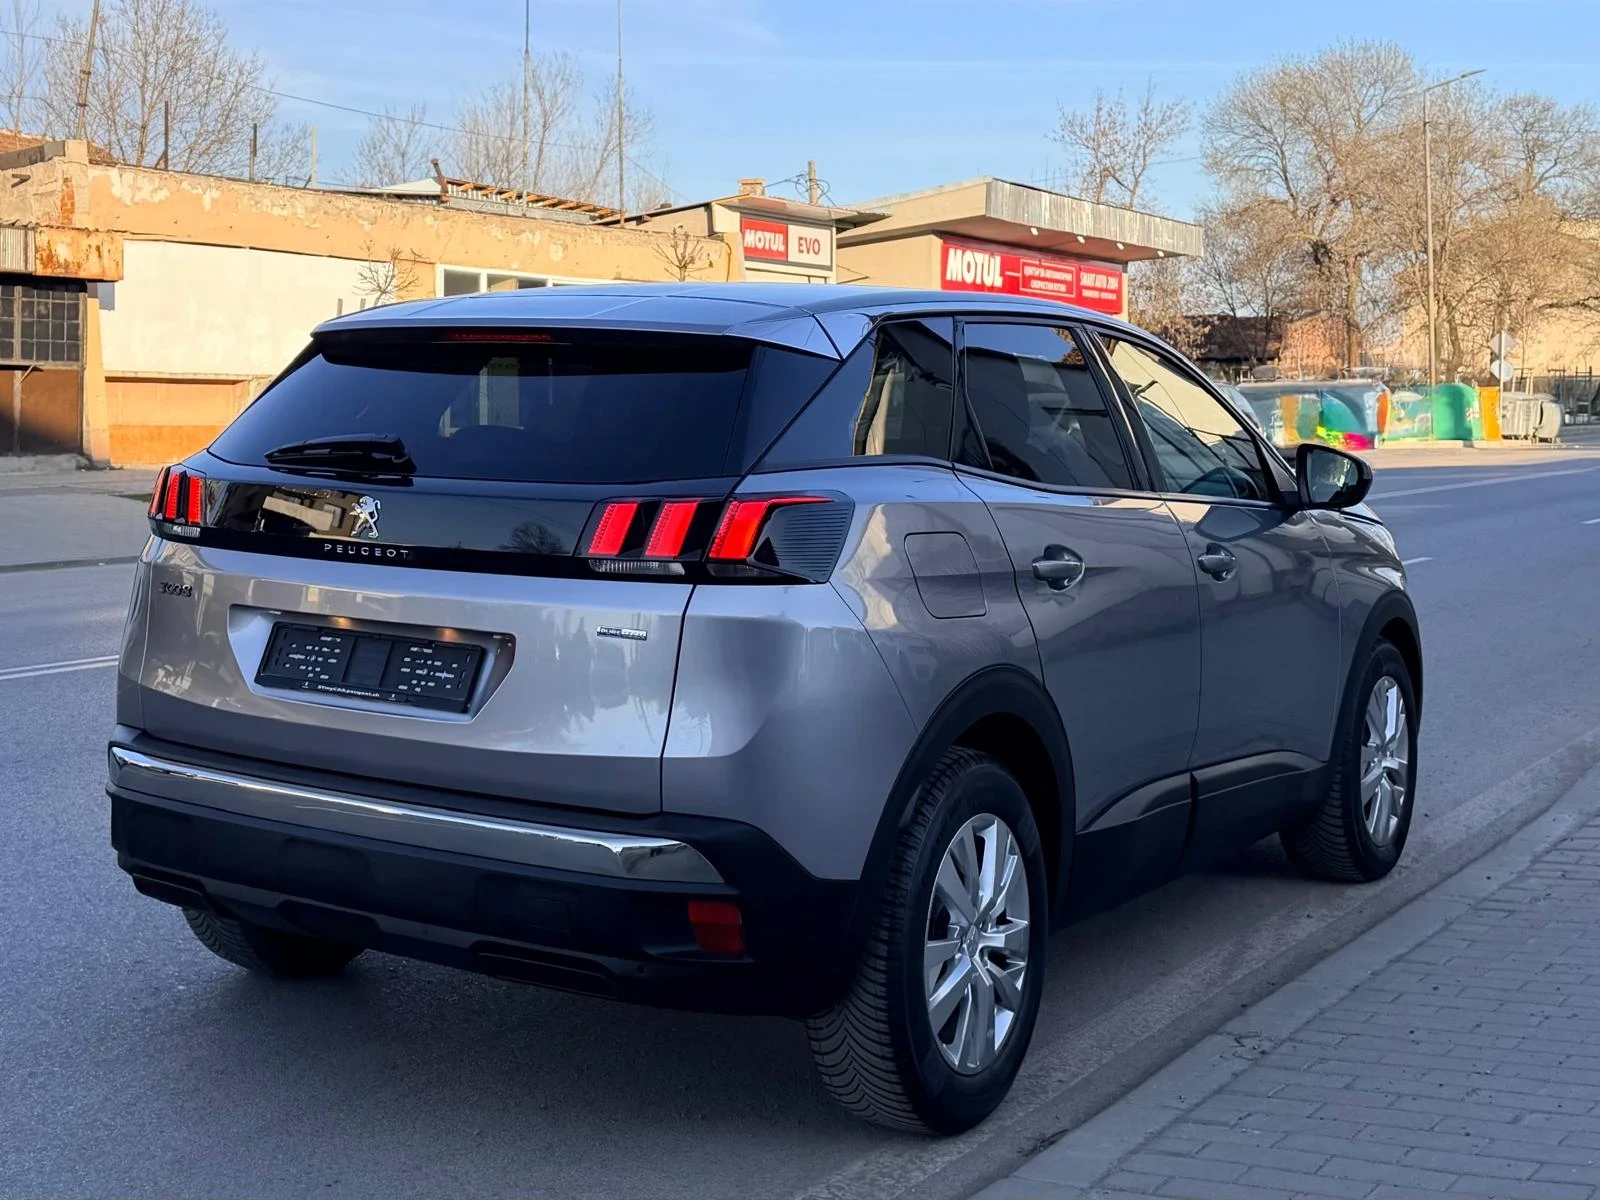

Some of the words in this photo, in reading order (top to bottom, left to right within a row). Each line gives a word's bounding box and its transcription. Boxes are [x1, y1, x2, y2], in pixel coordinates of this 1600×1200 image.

[744, 229, 784, 252] MOTUL
[798, 236, 821, 256] EVO
[946, 248, 1003, 288] MOTUL
[324, 543, 409, 558] PEUGEOT
